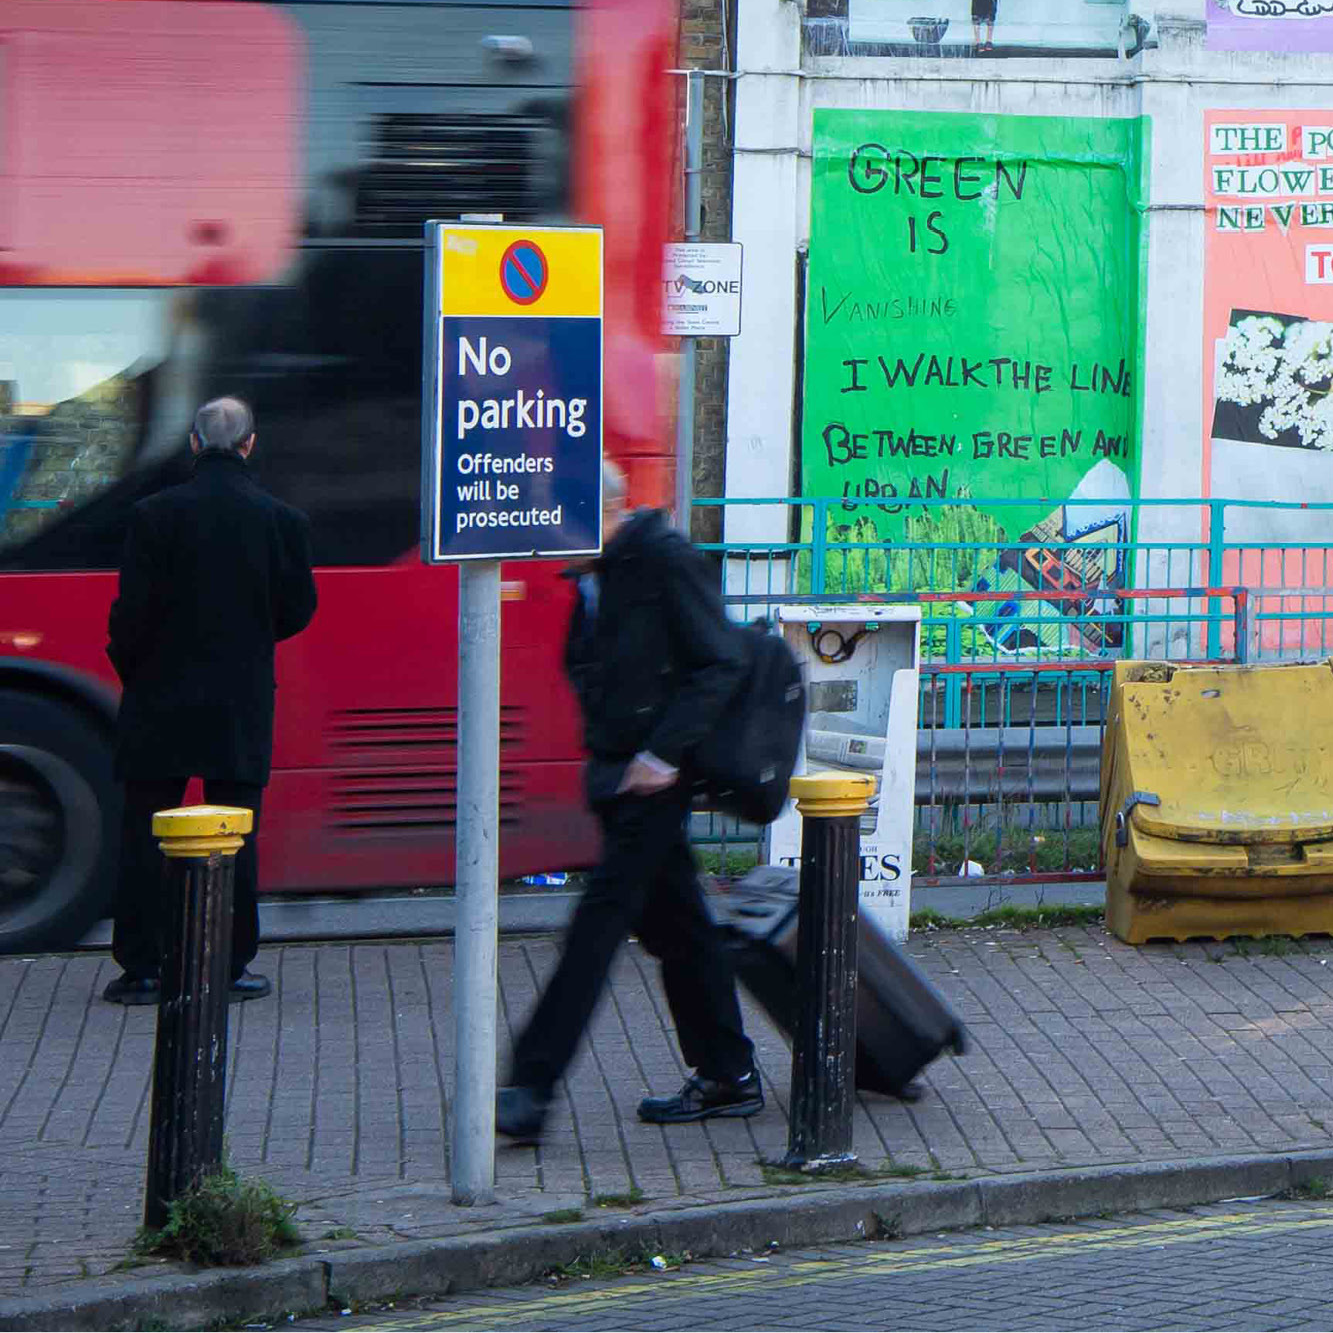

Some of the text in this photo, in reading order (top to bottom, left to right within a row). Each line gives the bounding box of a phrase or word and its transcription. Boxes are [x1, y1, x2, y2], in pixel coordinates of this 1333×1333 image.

[1215, 127, 1283, 152] THE
[849, 143, 1027, 200] GREEN
[907, 211, 949, 255] IS
[692, 280, 739, 294] ZONE
[458, 336, 512, 376] No
[841, 359, 870, 394] I
[878, 353, 988, 388] WALK
[989, 357, 1053, 393] THE
[458, 389, 587, 440] parking
[457, 454, 554, 474] Offenders
[822, 422, 956, 467] BETWEEN
[972, 429, 1082, 460] GREEN
[457, 480, 519, 501] will be
[456, 506, 562, 533] prosecuted
